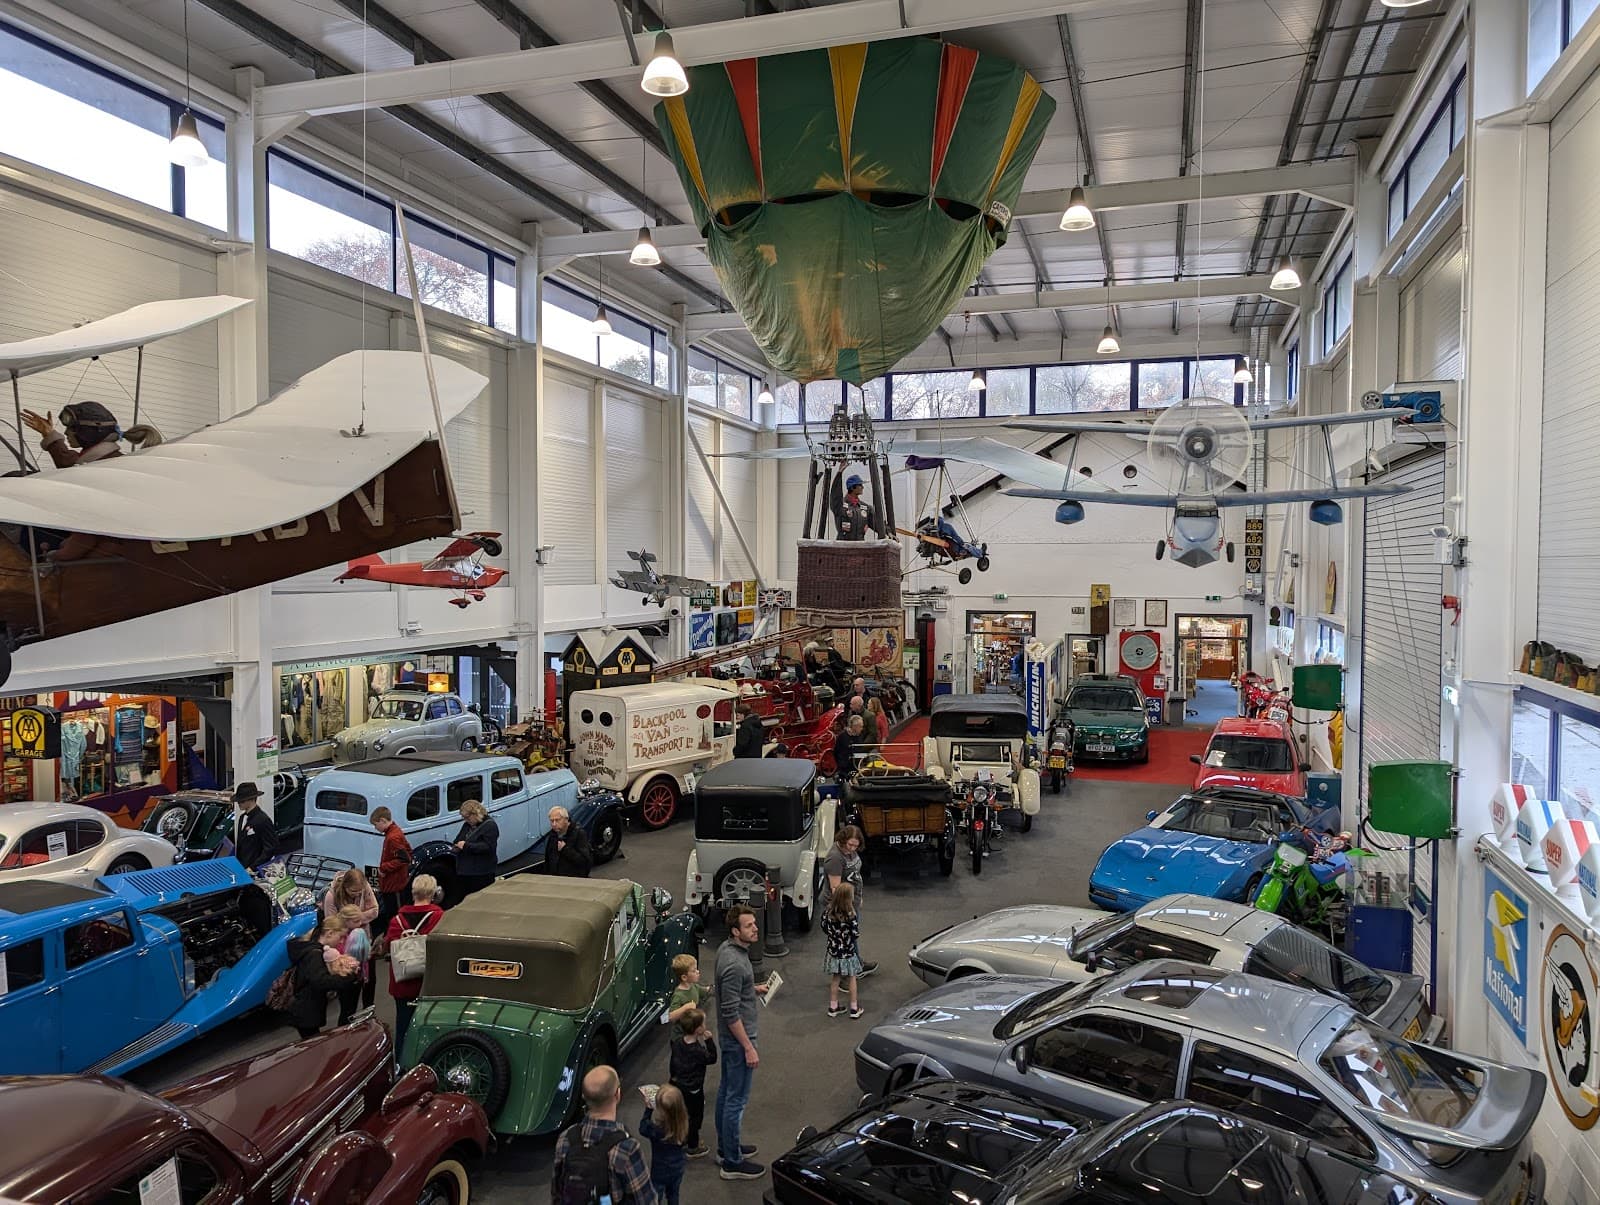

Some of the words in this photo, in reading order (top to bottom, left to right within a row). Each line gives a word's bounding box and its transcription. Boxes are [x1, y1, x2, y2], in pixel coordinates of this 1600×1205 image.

[1030, 662, 1040, 728] MICHELIN
[633, 708, 687, 729] BLACKPOOL
[645, 726, 671, 743] VAN
[15, 750, 45, 758] GARAGE
[632, 736, 684, 760] TRANSPORT
[889, 835, 902, 844] DS
[904, 834, 925, 843] 7447
[1546, 838, 1562, 865] SUPER
[1579, 860, 1597, 892] NATIONAL
[1486, 956, 1523, 1025] National
